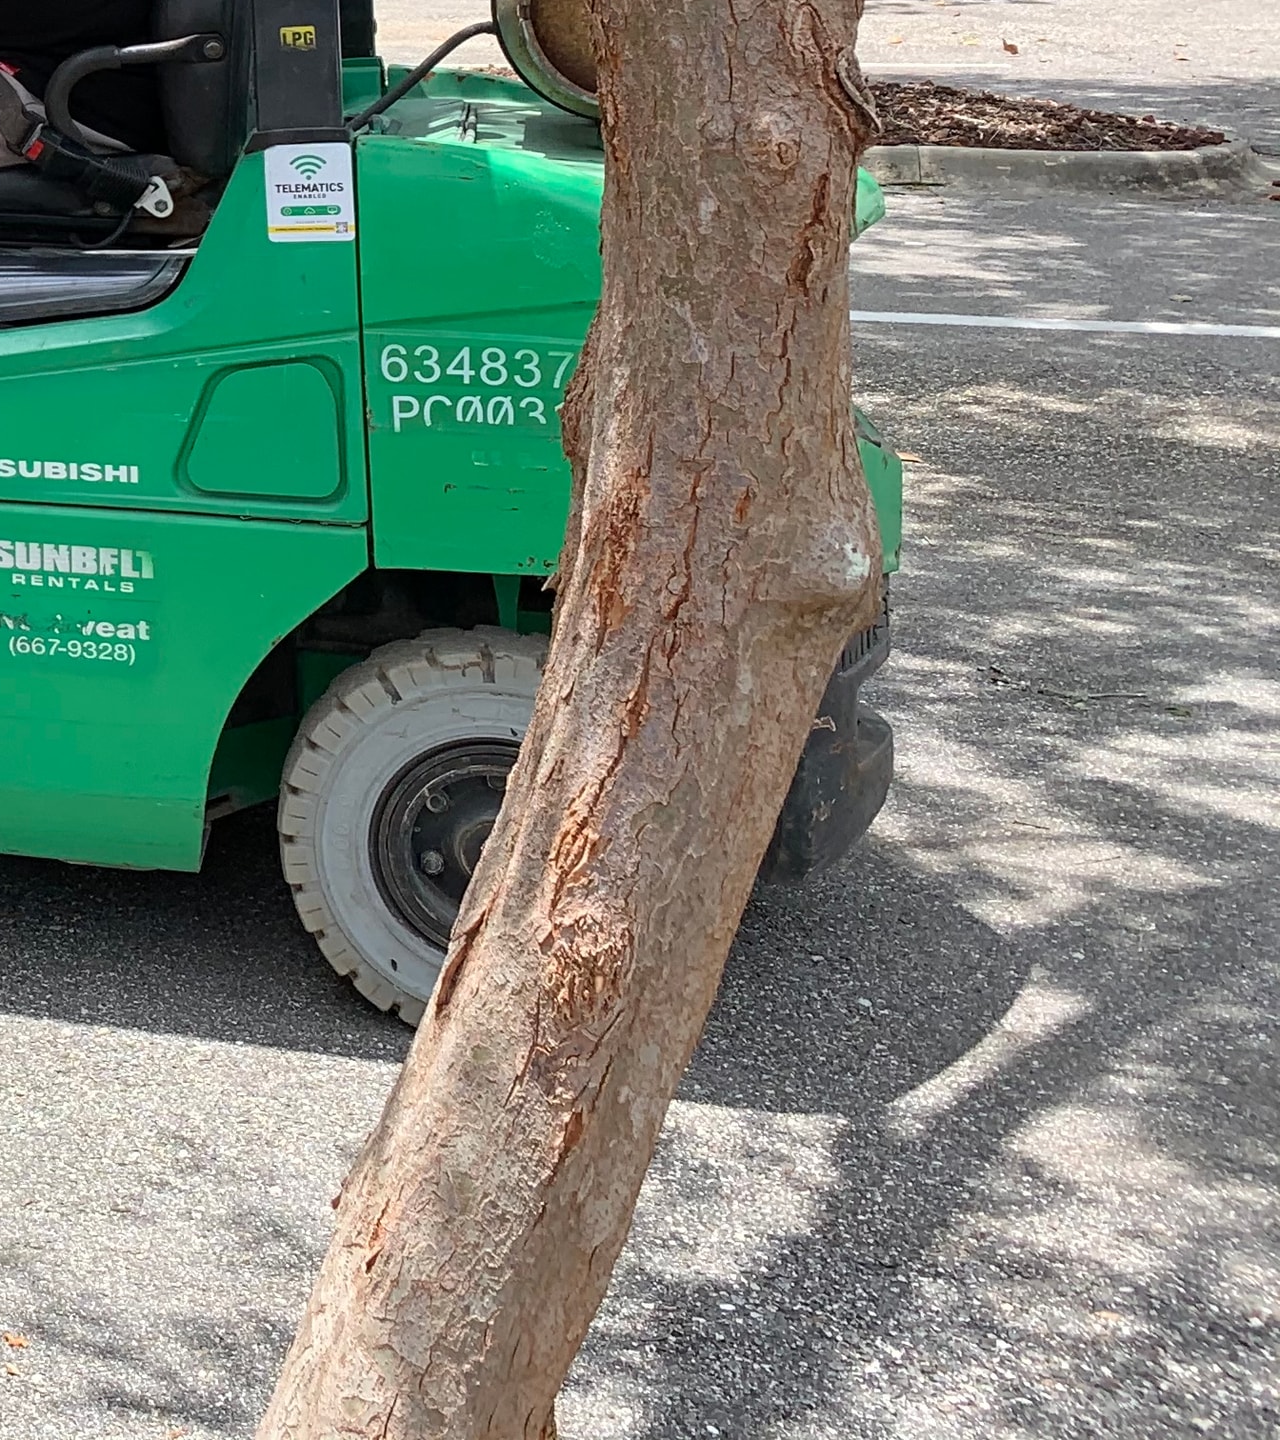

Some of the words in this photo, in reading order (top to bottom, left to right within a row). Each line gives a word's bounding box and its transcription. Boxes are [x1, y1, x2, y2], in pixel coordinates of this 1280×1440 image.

[282, 31, 314, 47] LPG
[274, 182, 345, 194] TELEMATICS
[380, 344, 574, 389] 634837
[392, 395, 567, 433] PC003
[12, 573, 135, 593] RENTALS
[9, 636, 137, 666] (667-9328)
